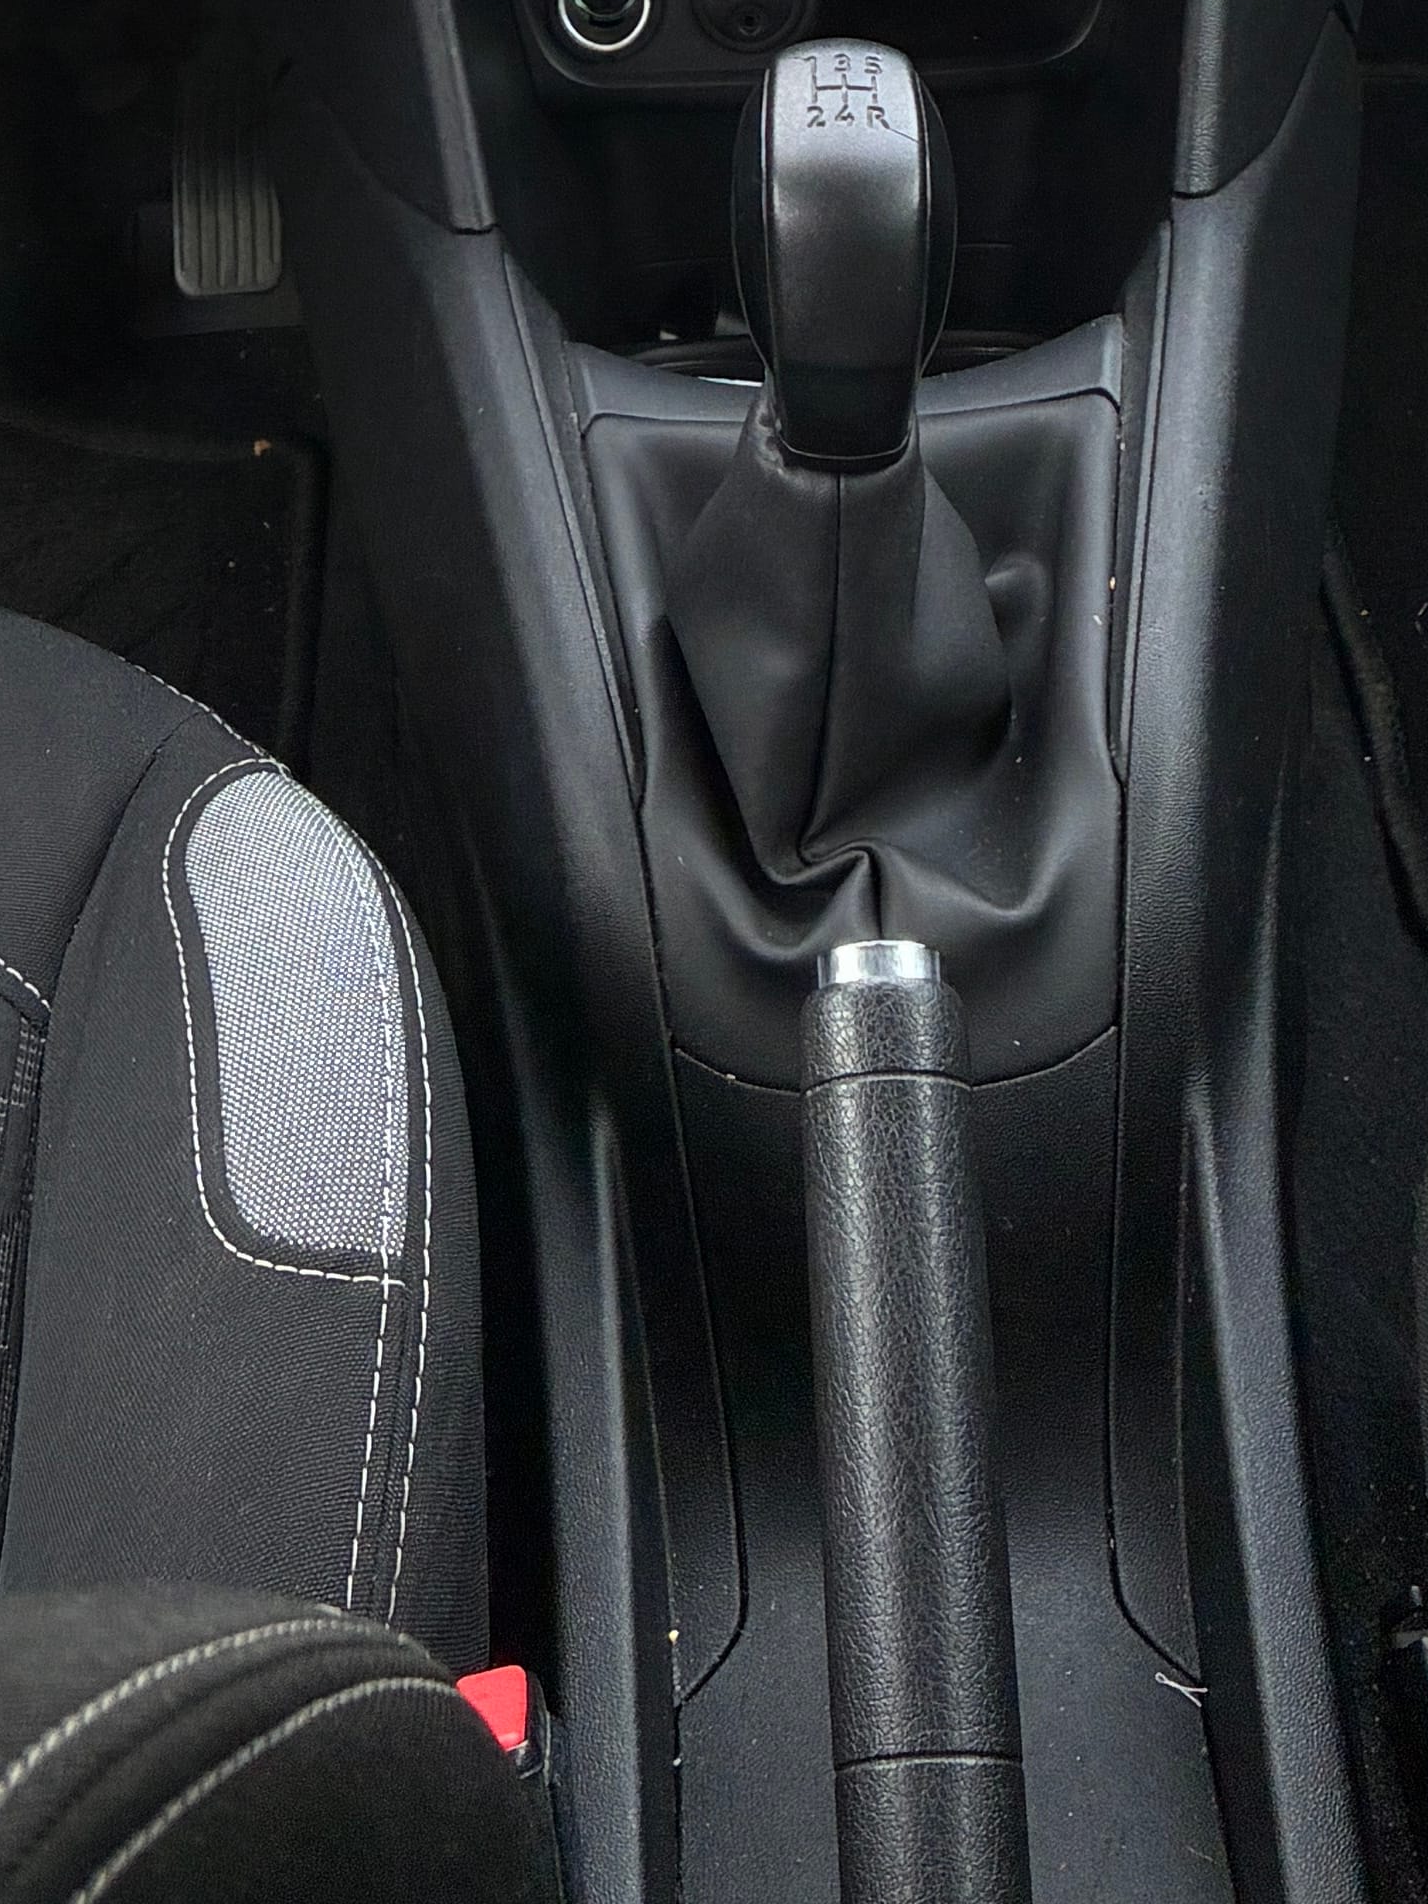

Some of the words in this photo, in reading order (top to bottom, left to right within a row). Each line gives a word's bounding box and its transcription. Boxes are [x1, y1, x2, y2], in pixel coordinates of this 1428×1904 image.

[834, 53, 851, 72] 3
[864, 55, 883, 74] 5
[807, 105, 826, 128] 2
[834, 103, 855, 127] 4
[866, 105, 891, 128] R
